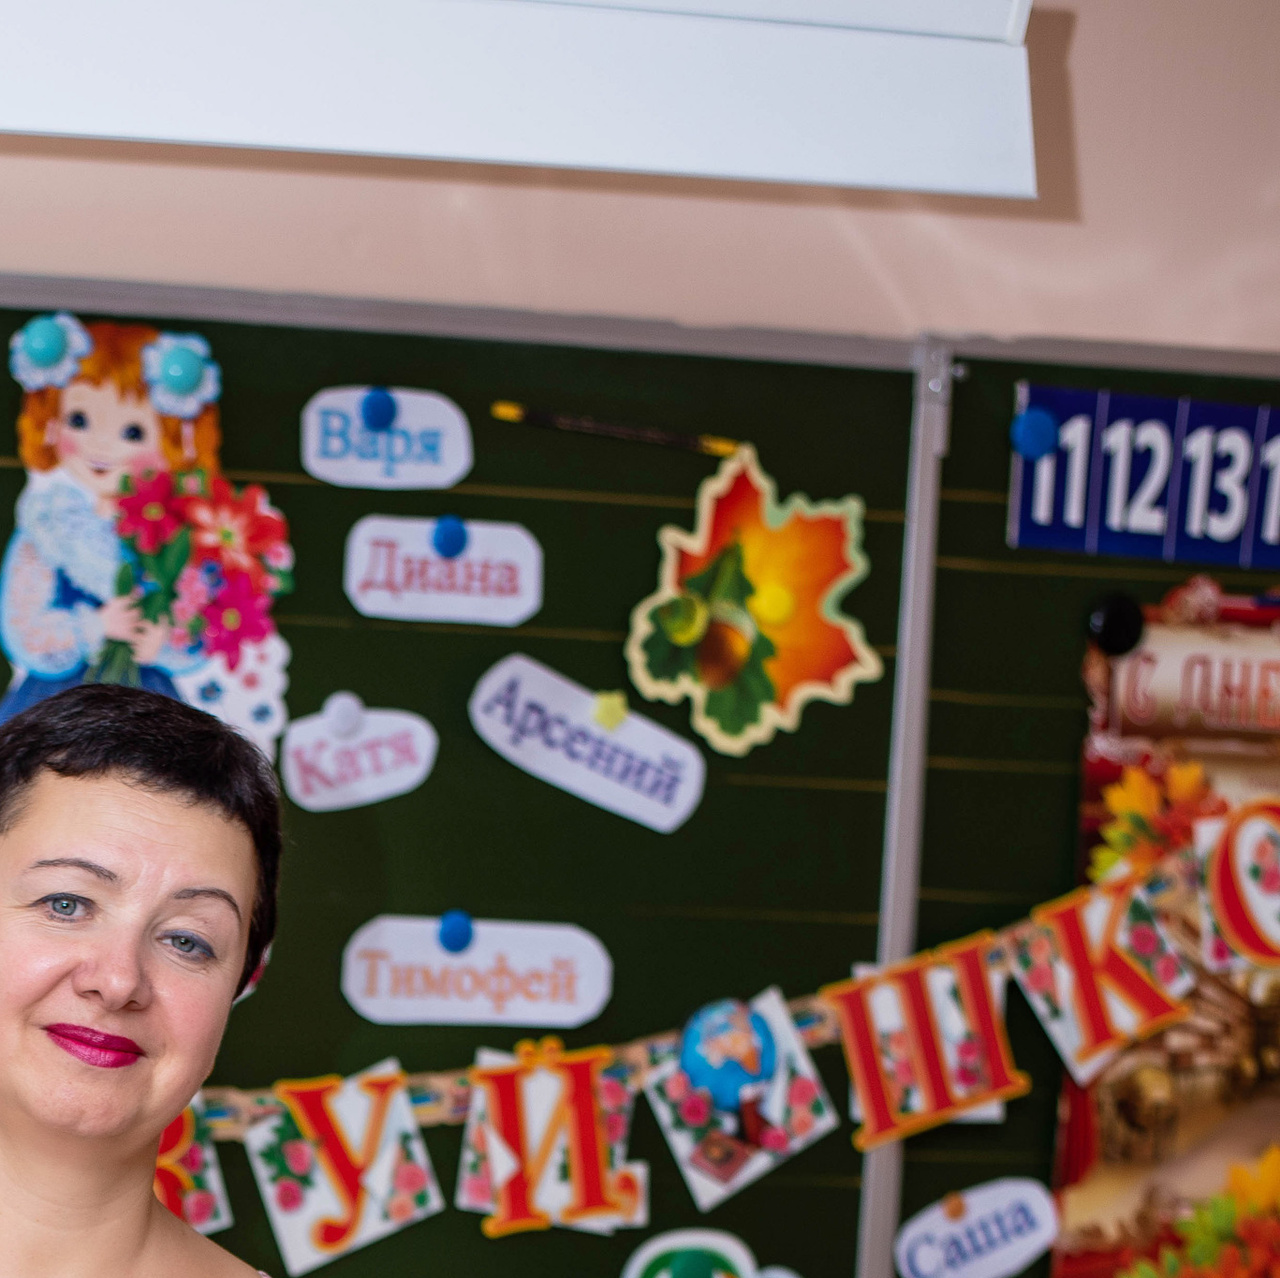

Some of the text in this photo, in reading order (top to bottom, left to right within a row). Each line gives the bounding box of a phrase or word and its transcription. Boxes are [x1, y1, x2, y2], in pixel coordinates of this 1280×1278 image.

[316, 408, 444, 477] Варя
[1102, 418, 1173, 536] 12
[1184, 425, 1253, 543] 13
[357, 537, 521, 602] Диана
[290, 729, 420, 797] Катя
[482, 675, 687, 808] Арсений
[356, 947, 581, 1015] Тимофей
